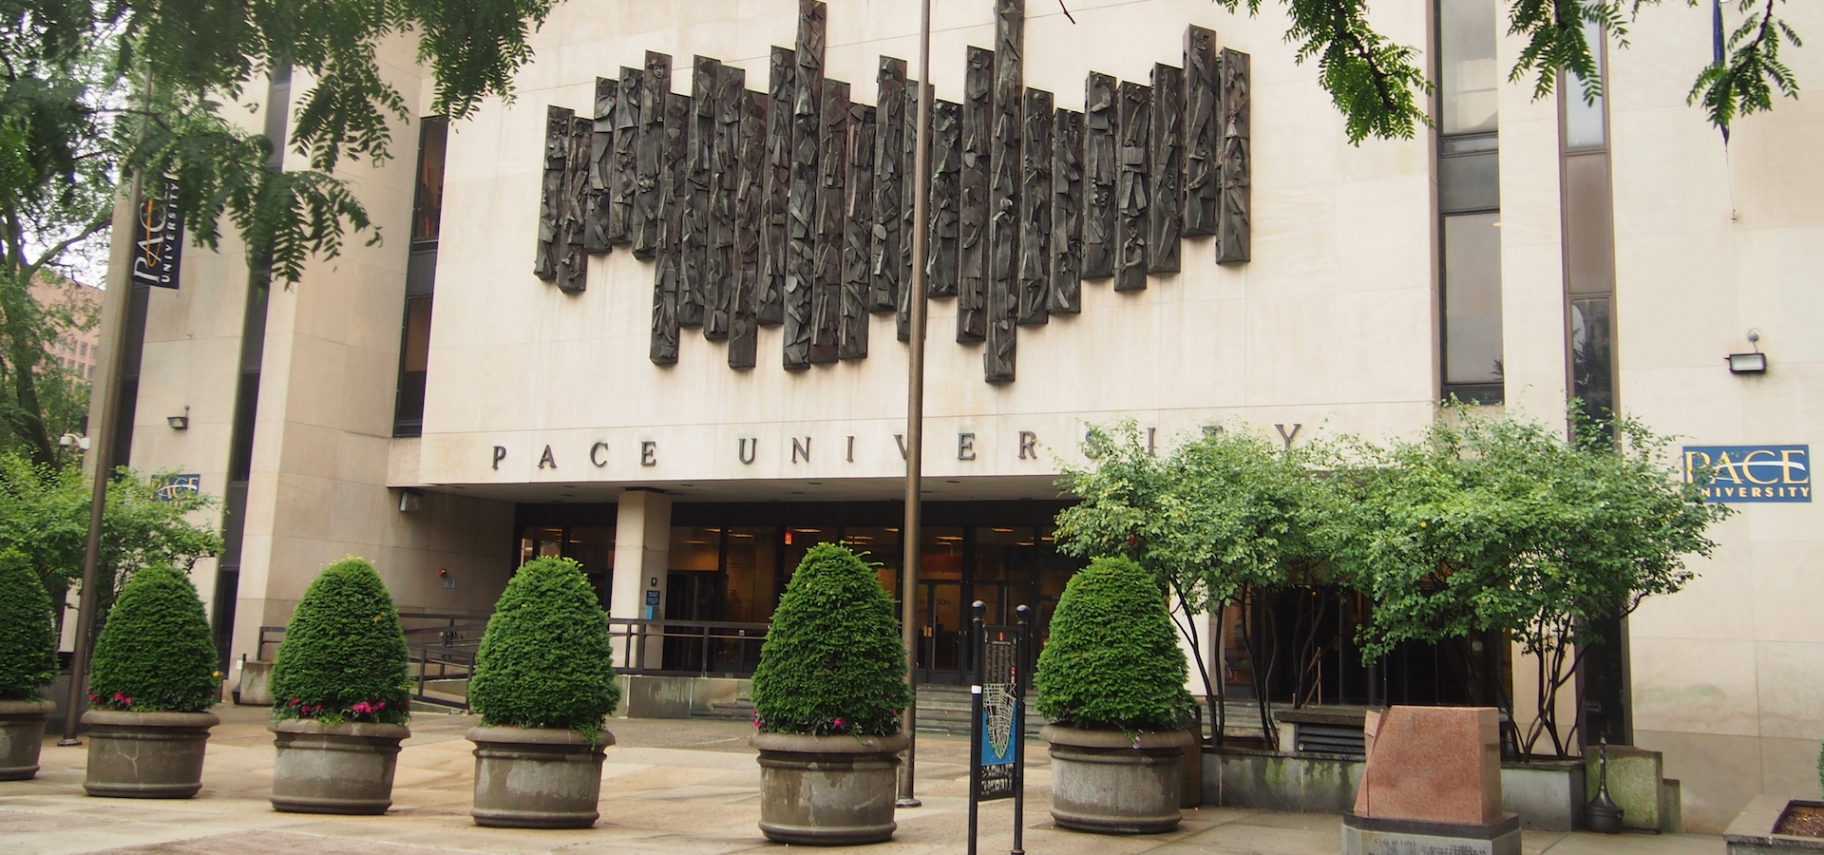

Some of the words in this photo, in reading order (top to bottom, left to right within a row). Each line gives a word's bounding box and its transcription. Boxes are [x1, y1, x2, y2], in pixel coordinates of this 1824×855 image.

[161, 182, 180, 283] UNIVERSITY
[491, 441, 657, 470] PACE
[1684, 450, 1810, 485] PACE
[1701, 486, 1810, 498] NIVERSITY
